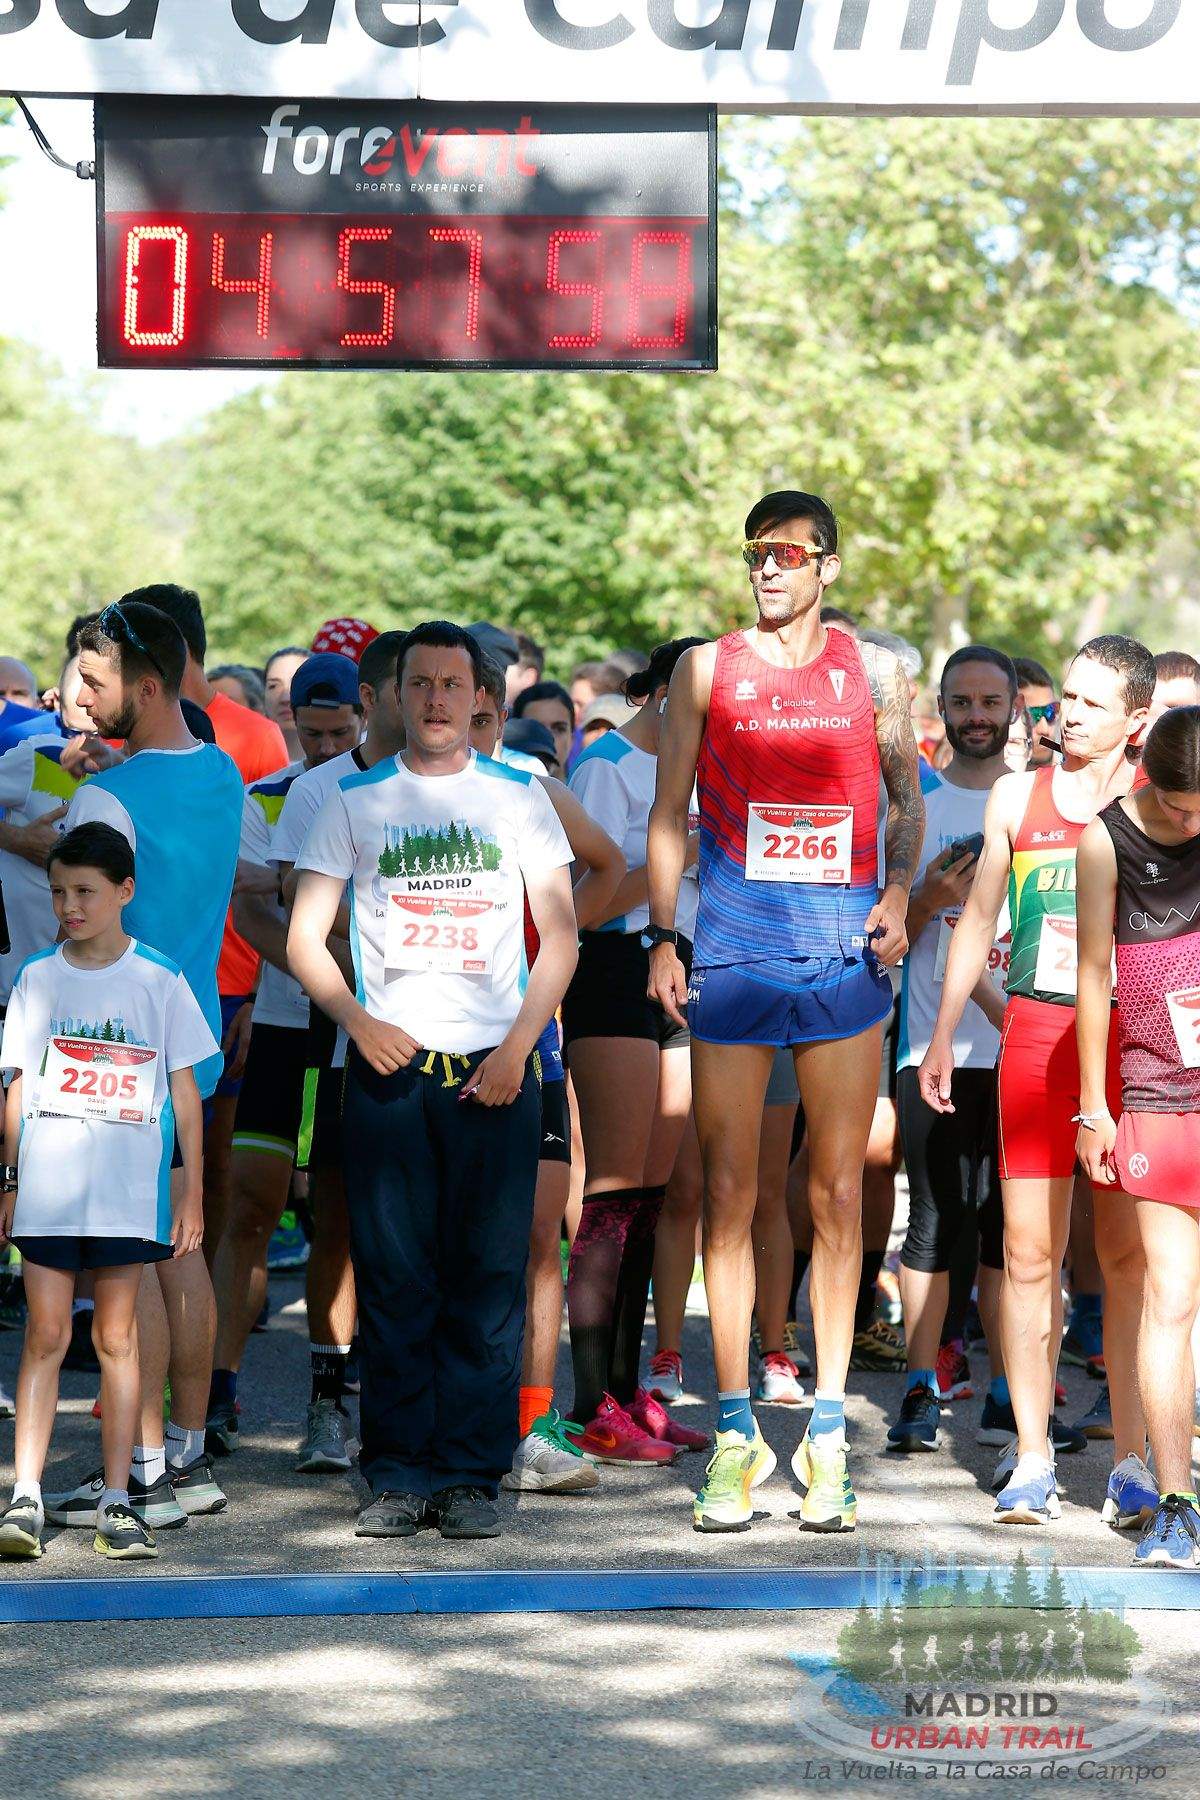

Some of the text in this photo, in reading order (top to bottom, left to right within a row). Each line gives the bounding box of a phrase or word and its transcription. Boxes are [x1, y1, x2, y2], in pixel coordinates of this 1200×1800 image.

[524, 0, 1182, 87] apo
[260, 104, 541, 177] forevent
[355, 182, 484, 193] SPORTS EXPERIENCE
[734, 717, 852, 732] A.D. MARATHON
[763, 833, 838, 860] 2266
[407, 878, 472, 891] MADRID
[402, 923, 479, 951] 2238
[60, 1067, 138, 1100] 2205
